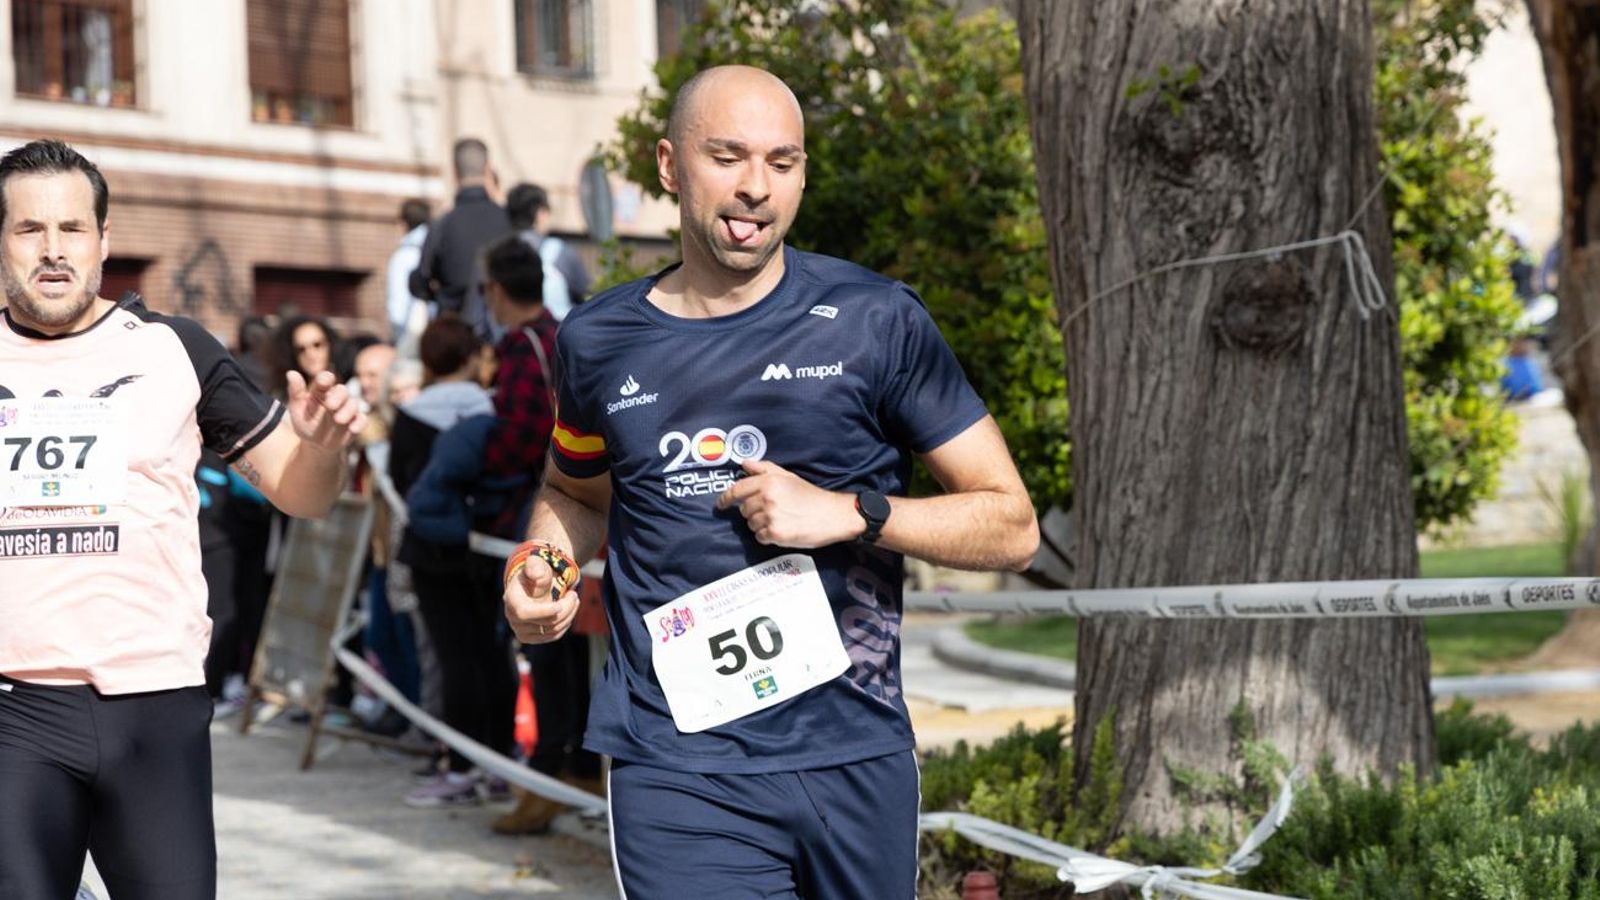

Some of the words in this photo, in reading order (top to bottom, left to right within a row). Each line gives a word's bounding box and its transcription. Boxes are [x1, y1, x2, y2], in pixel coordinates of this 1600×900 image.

[796, 361, 843, 380] mupol
[606, 392, 660, 415] Santander
[4, 435, 97, 471] 767
[658, 423, 768, 473] 200
[56, 534, 67, 553] a
[71, 525, 115, 553] nado
[758, 560, 793, 577] POPULAR
[1521, 584, 1575, 603] DEPORTES
[708, 616, 784, 676] 50
